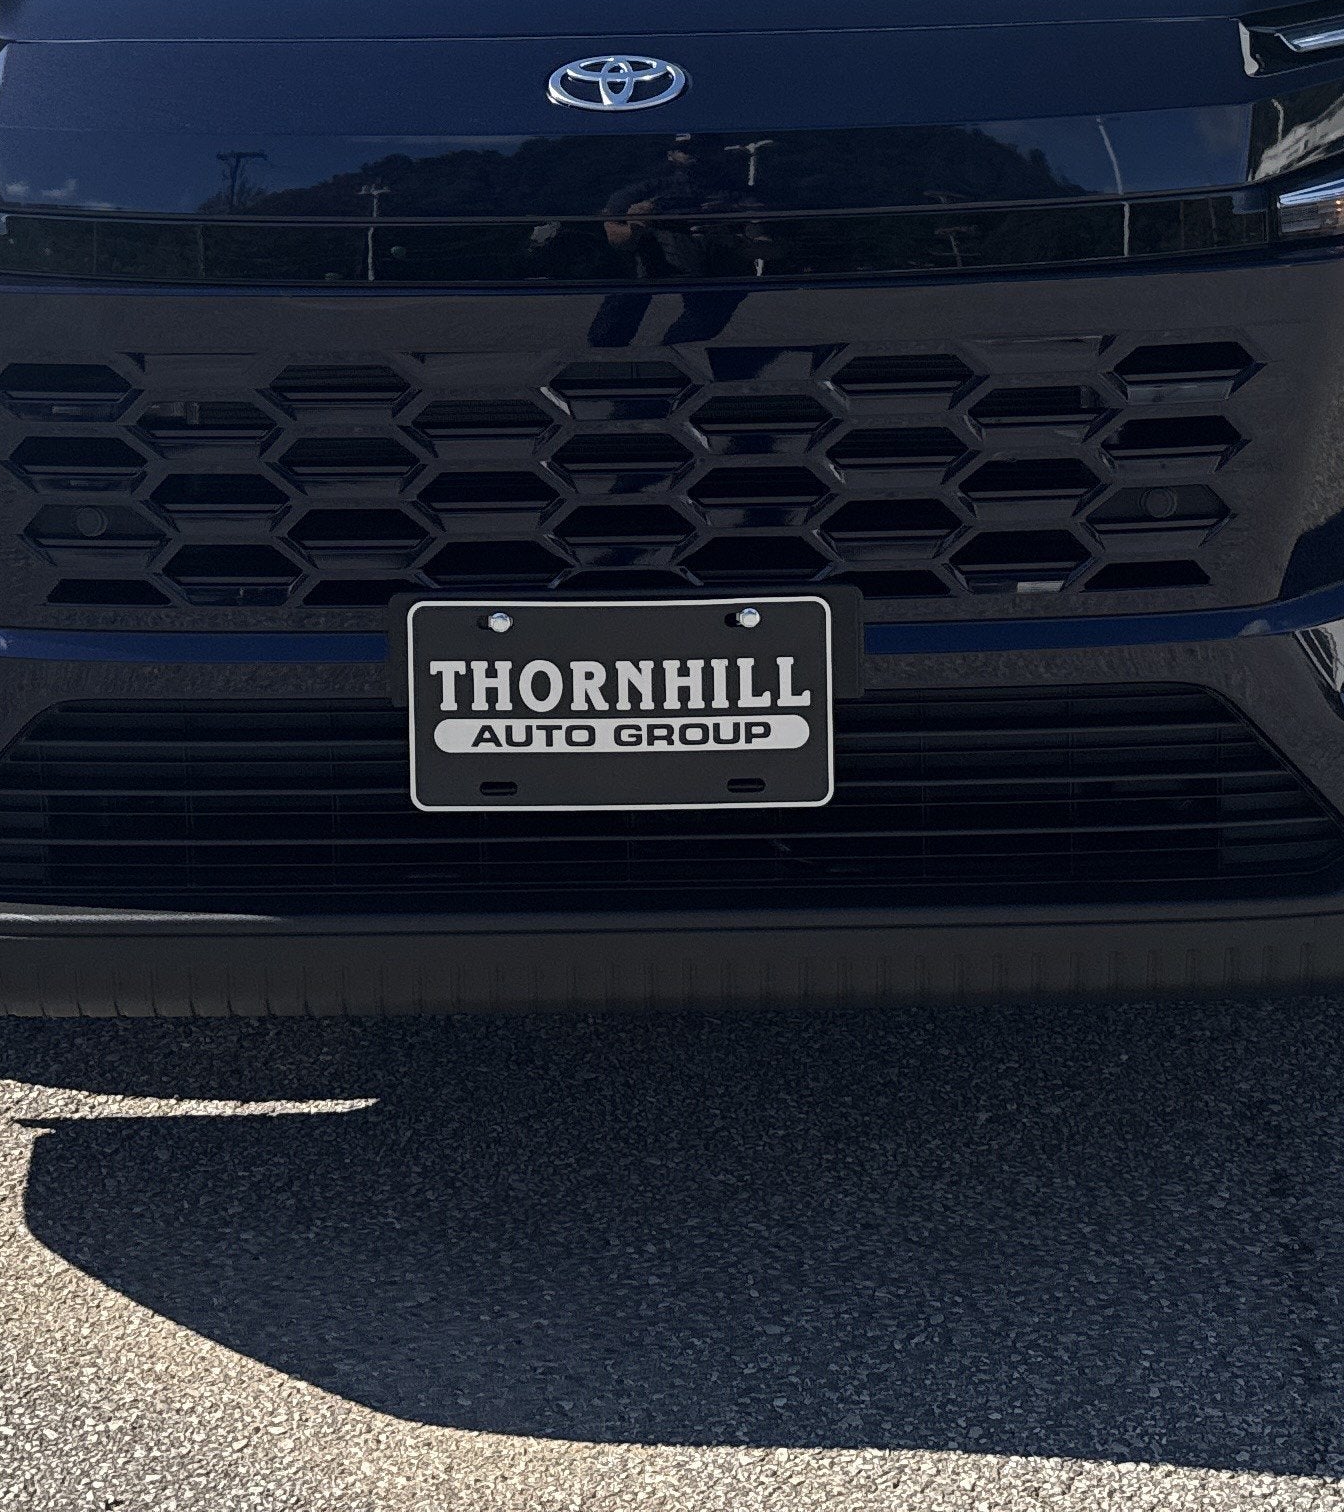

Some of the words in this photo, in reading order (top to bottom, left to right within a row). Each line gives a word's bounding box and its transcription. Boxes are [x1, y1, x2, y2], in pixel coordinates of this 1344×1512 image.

[429, 656, 811, 713] THORNHILL
[471, 723, 596, 748] AUTO
[613, 721, 772, 746] GROUP
